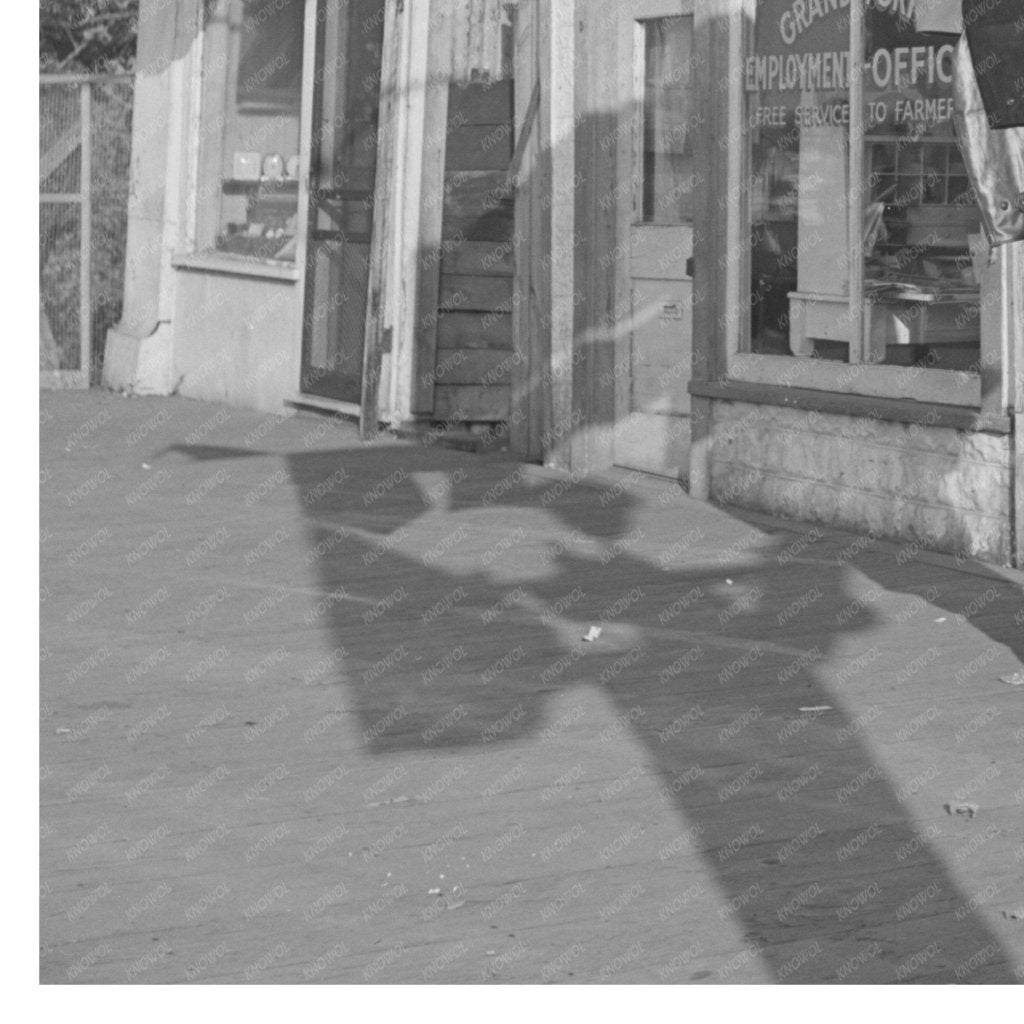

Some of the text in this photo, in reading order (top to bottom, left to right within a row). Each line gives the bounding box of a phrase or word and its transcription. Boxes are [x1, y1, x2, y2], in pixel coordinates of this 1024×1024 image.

[756, 105, 787, 125] FREE
[794, 104, 850, 125] SERVICE
[867, 101, 887, 123] TO
